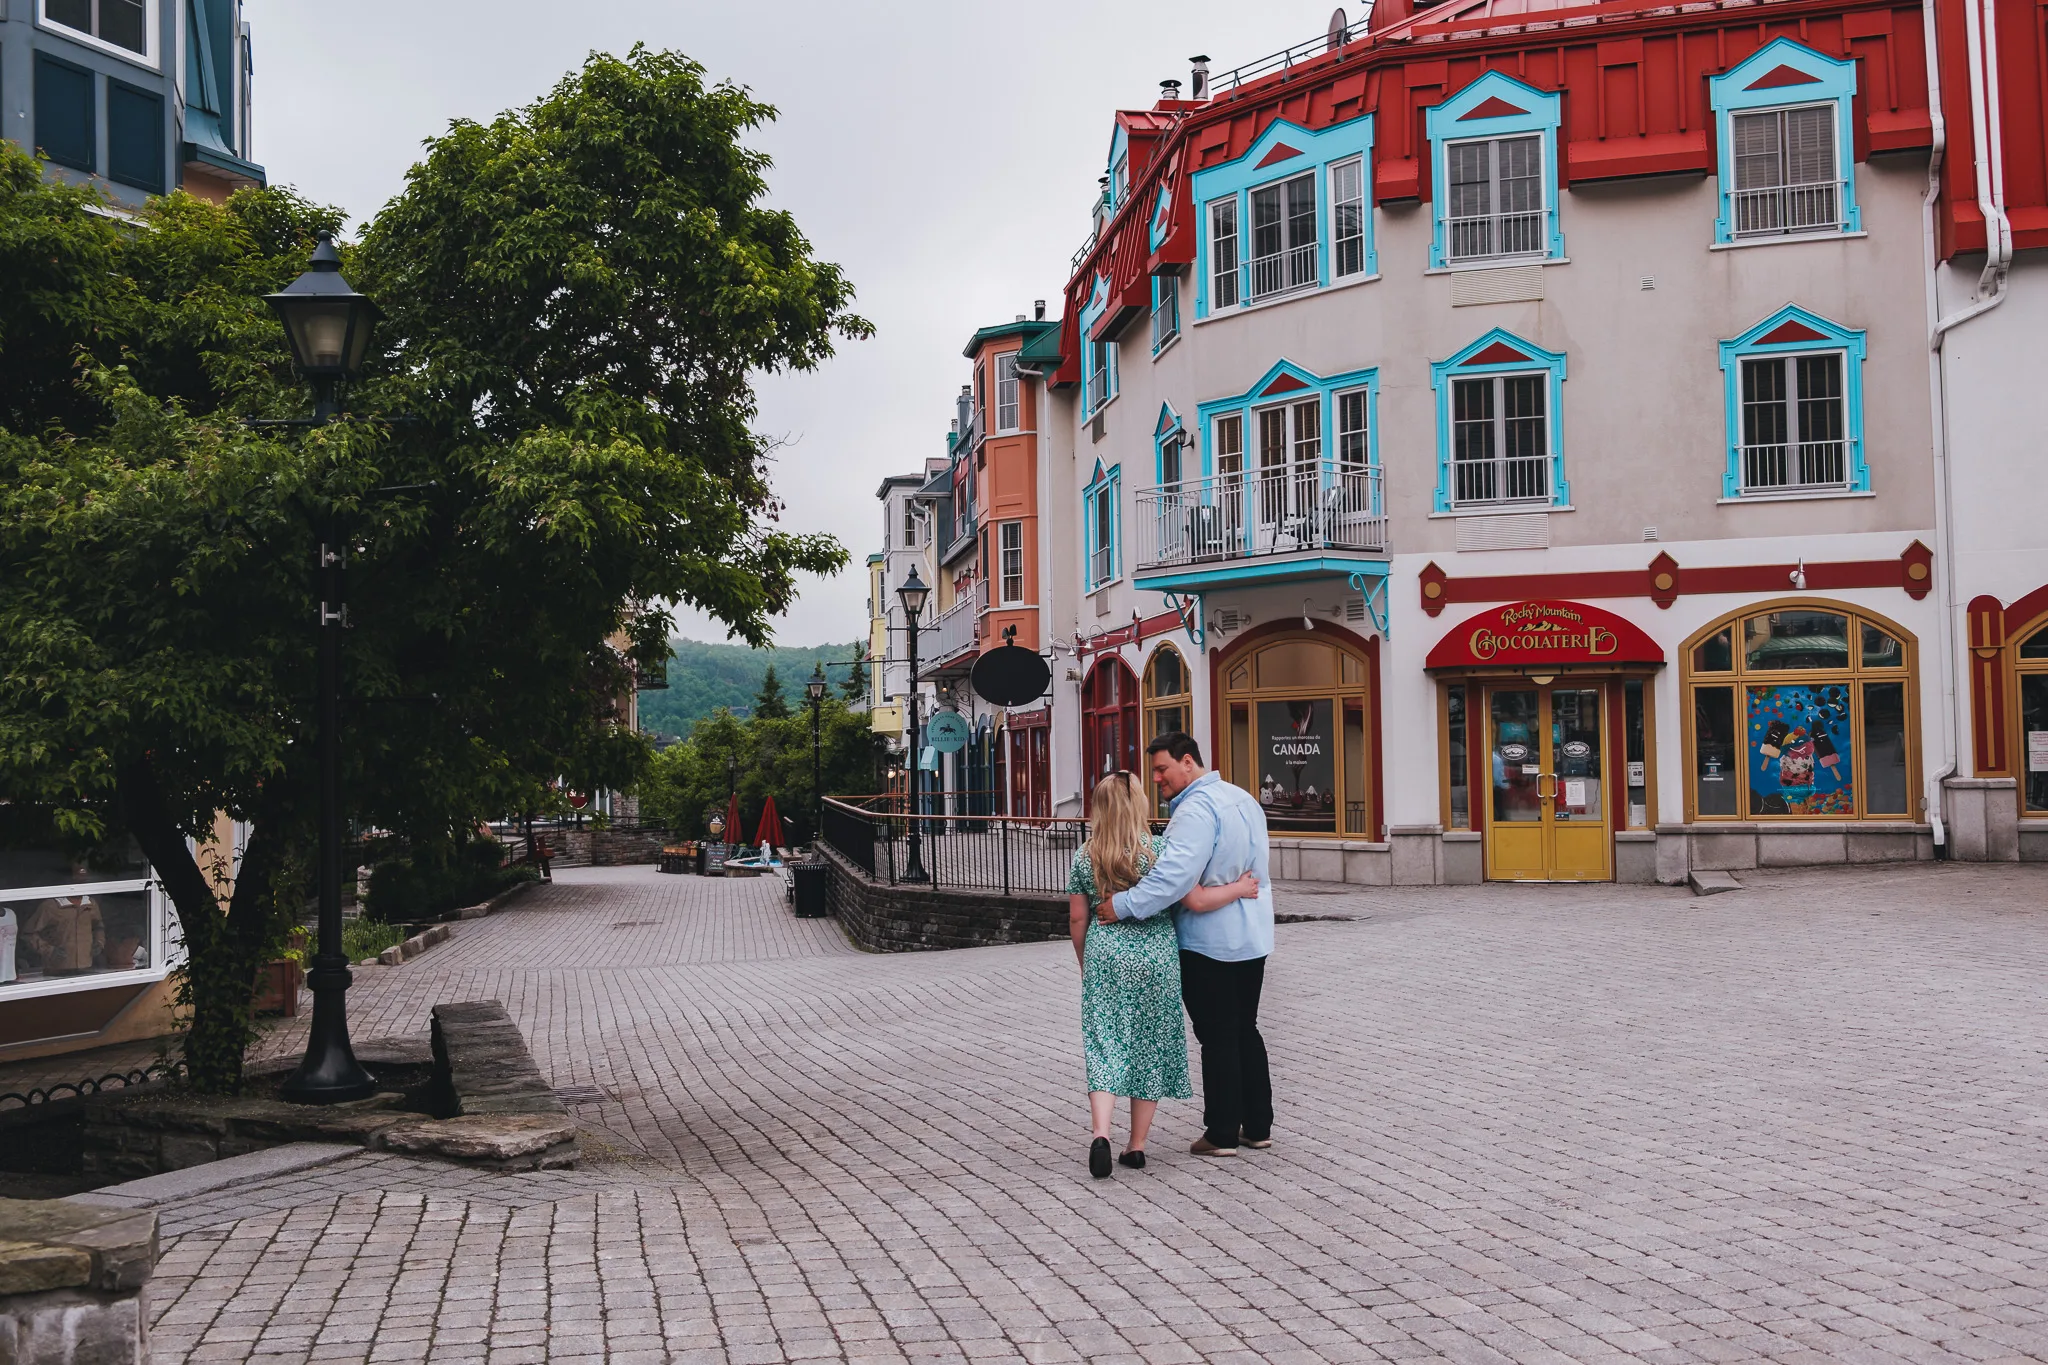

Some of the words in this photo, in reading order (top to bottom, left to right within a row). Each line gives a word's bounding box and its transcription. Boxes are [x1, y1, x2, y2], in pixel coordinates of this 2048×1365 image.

[1501, 604, 1534, 626] Rocky
[1530, 603, 1583, 625] Mountain
[1469, 626, 1618, 660] CHOCOLATERIE
[1272, 744, 1320, 755] CANADA
